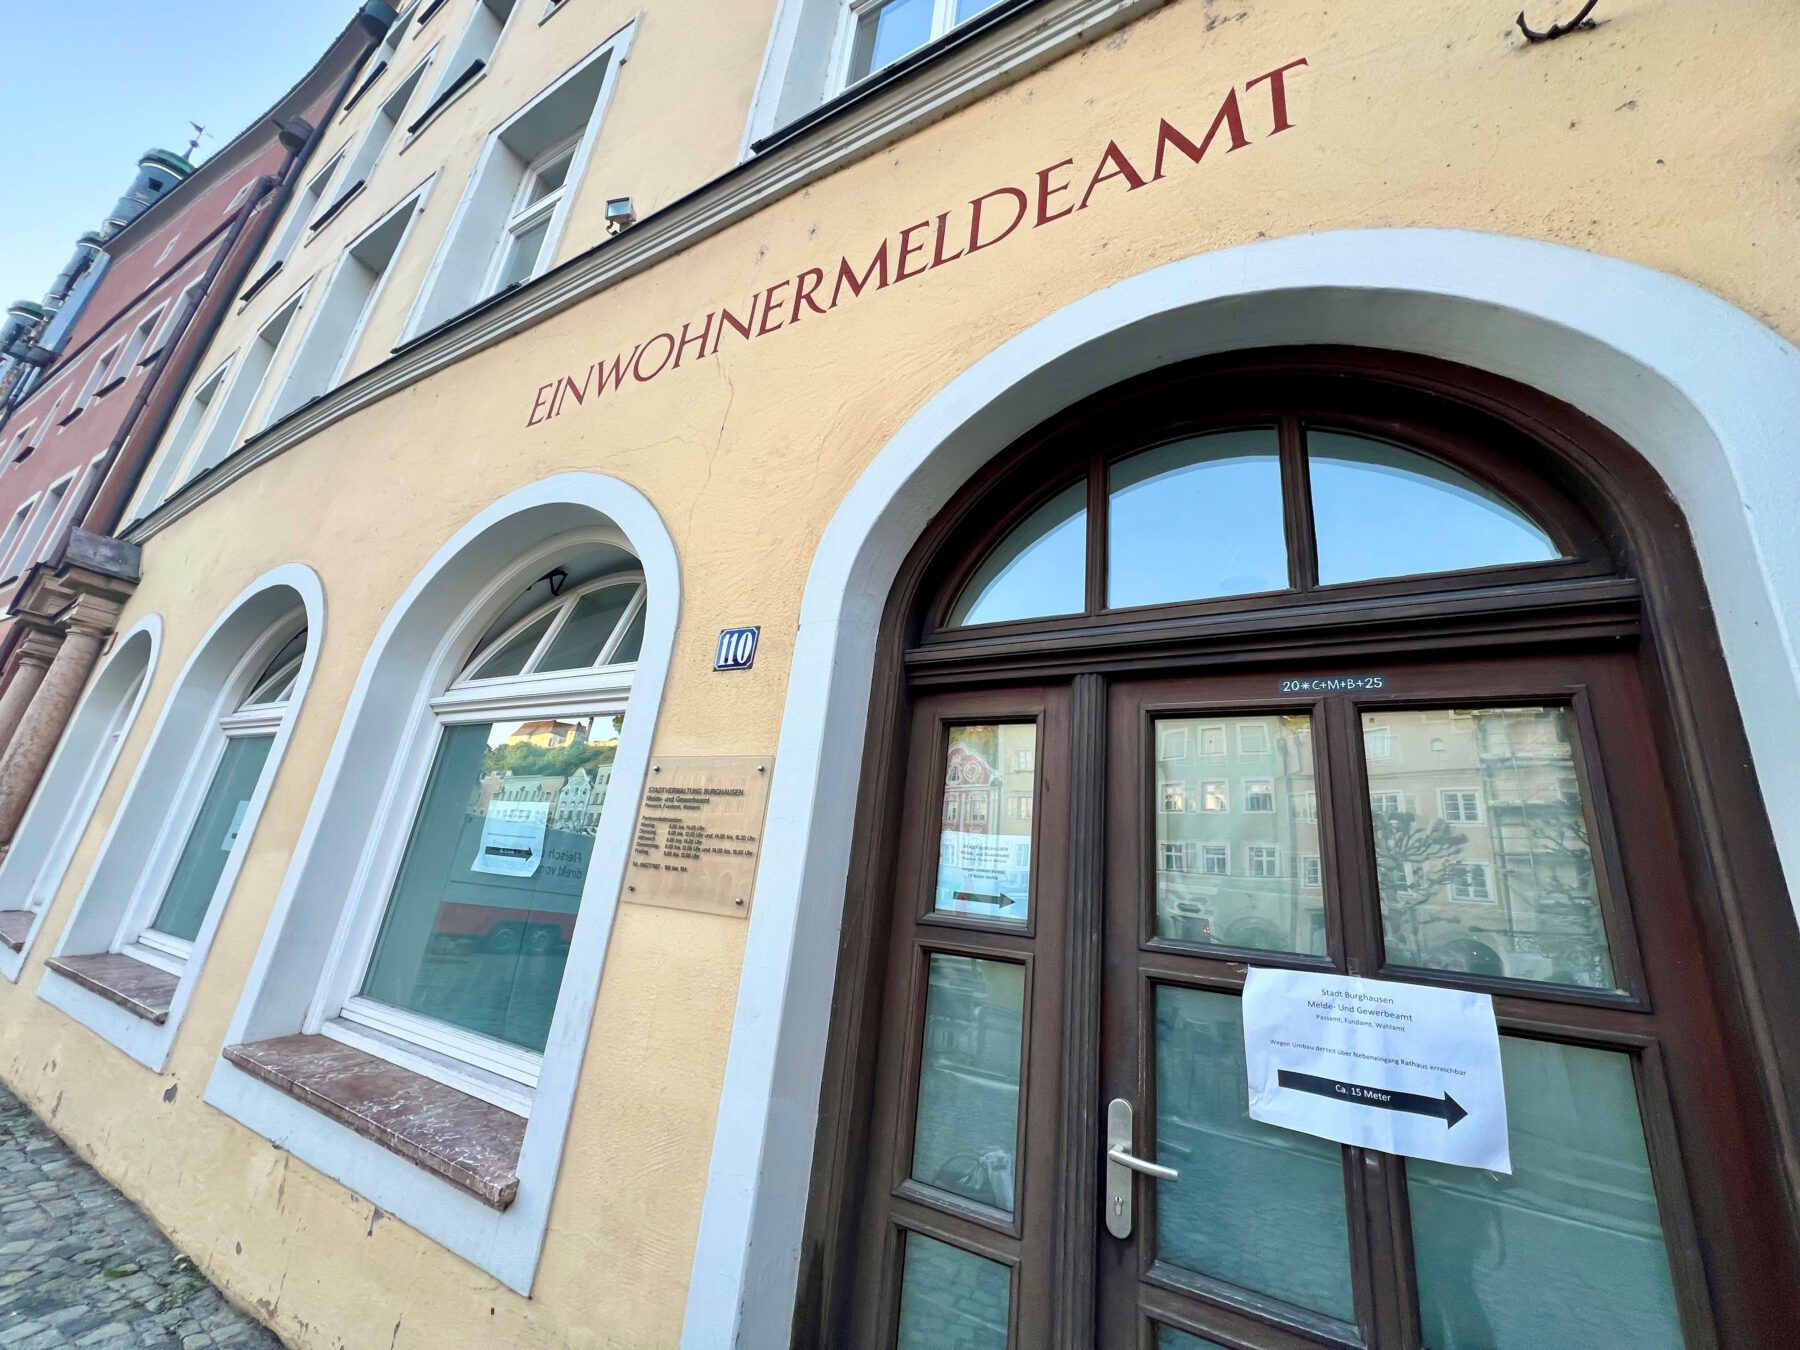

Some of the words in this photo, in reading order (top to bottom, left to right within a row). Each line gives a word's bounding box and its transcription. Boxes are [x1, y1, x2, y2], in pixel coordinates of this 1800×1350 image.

[525, 57, 1308, 428] EINWOHNERMELDEAMT
[717, 632, 753, 665] 110
[648, 786, 702, 795] STADTVERWALTUNG
[703, 788, 744, 796] BURGHAUSEN
[1321, 988, 1343, 998] Stadt
[1344, 991, 1394, 1005] Burghausen
[1307, 1000, 1336, 1010] Melde-
[1338, 1003, 1355, 1013] Und
[1356, 1007, 1414, 1022] Gewerbeamt
[1316, 1013, 1343, 1024] Passamt,
[1344, 1017, 1374, 1028] Fundamt,
[1375, 1022, 1406, 1032] Wahlamt
[1270, 1039, 1291, 1048] Wegen
[1292, 1042, 1315, 1050] Umbau
[1315, 1045, 1337, 1054] derzeit
[1337, 1048, 1352, 1057] über
[1353, 1051, 1400, 1066] Nebeneingang
[1400, 1058, 1429, 1070] Rathaus
[1429, 1064, 1467, 1076] erreichbar
[1335, 1084, 1349, 1095] Ca.
[1351, 1087, 1362, 1097] 15
[1363, 1089, 1392, 1102] Meter
